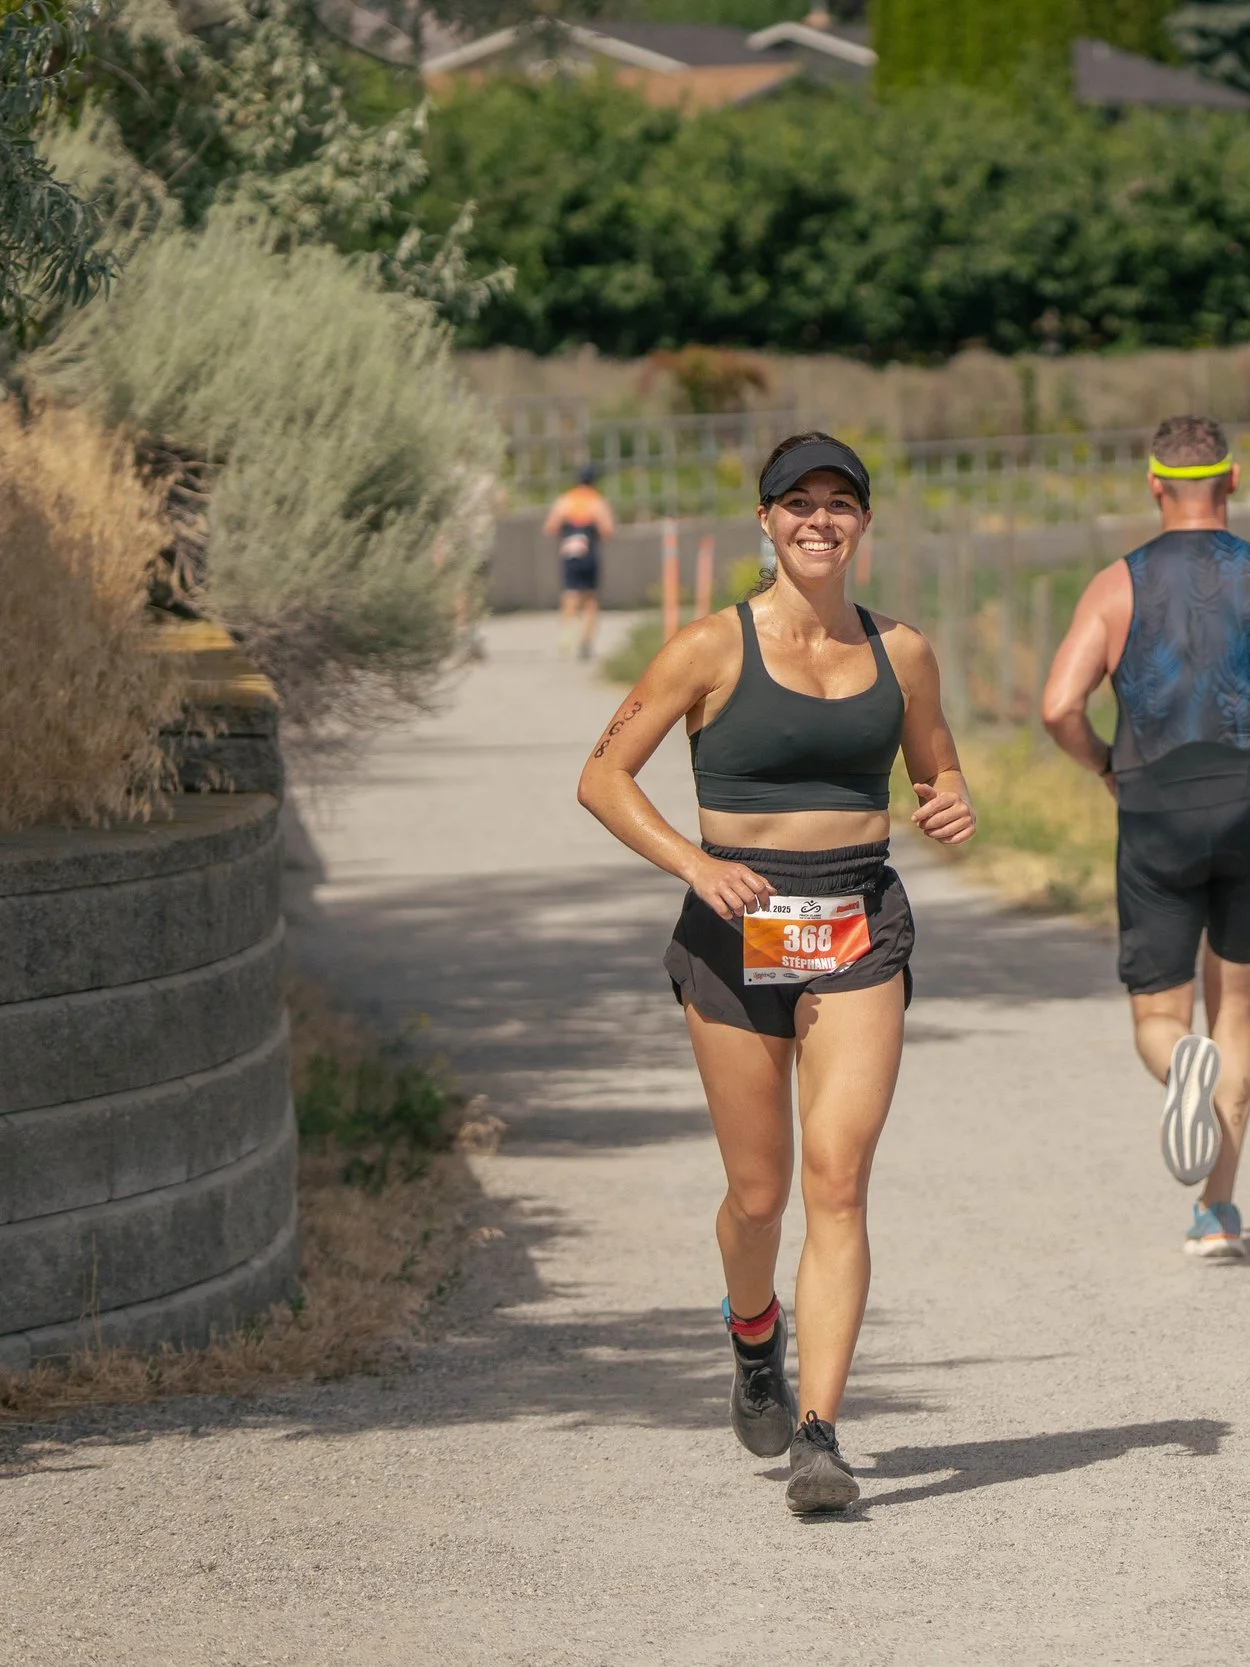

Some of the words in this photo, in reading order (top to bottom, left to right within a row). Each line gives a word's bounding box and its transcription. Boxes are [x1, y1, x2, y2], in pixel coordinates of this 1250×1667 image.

[593, 701, 642, 758] 368
[773, 905, 791, 914] 2025
[783, 924, 833, 953] 368
[781, 955, 837, 970] STÉPHANIE
